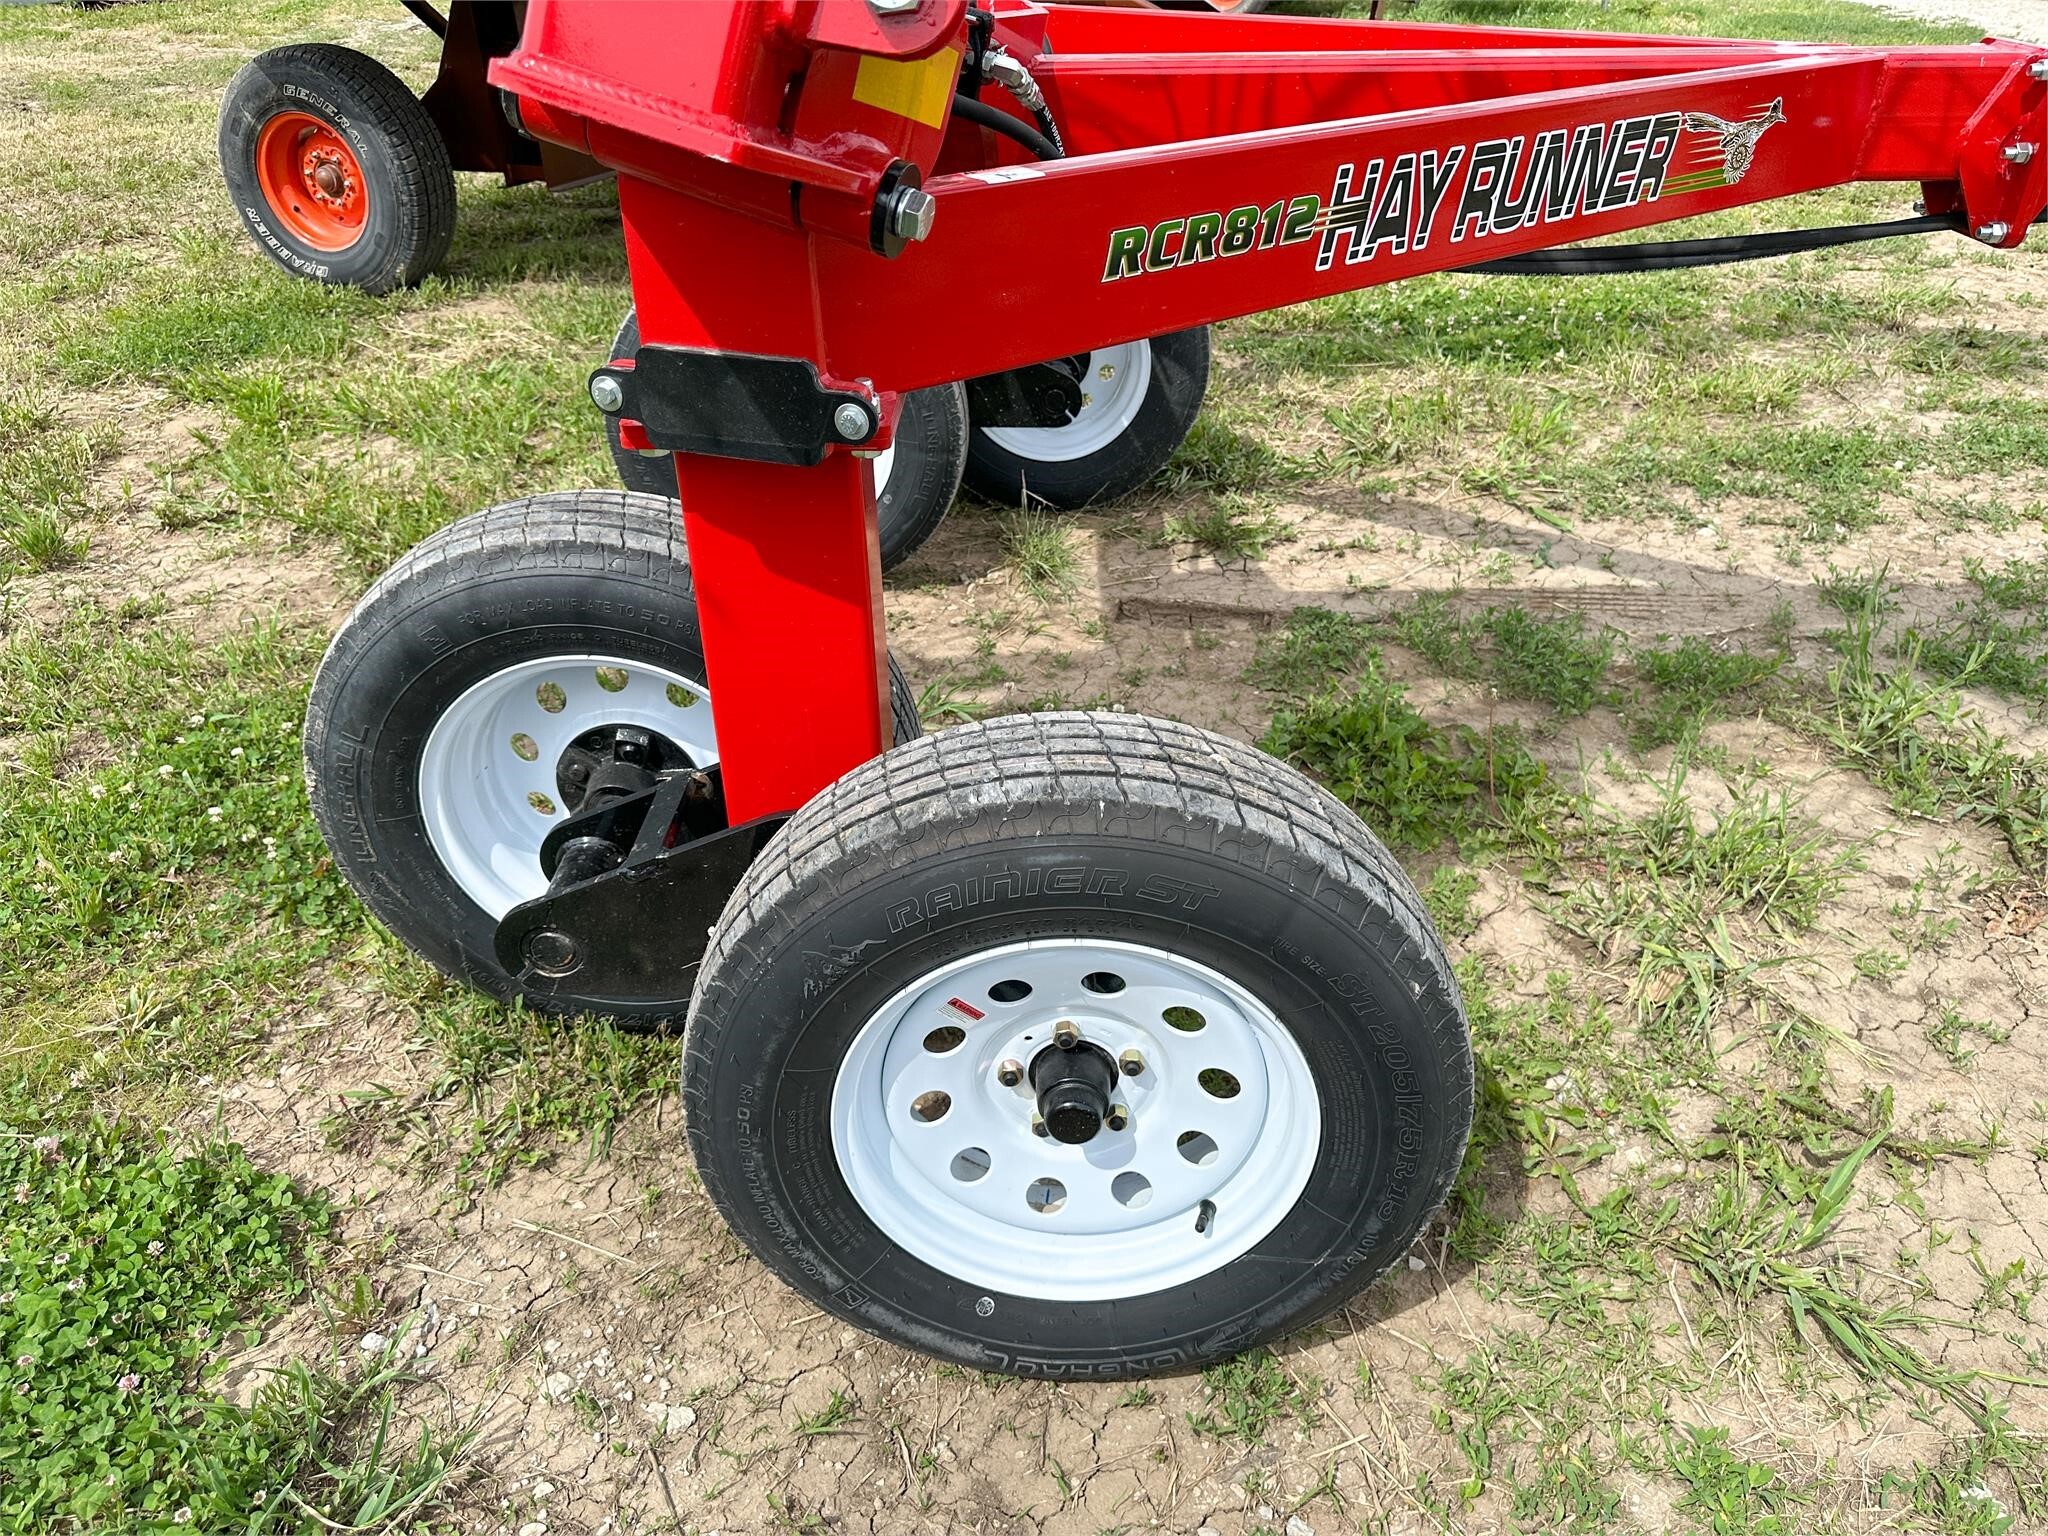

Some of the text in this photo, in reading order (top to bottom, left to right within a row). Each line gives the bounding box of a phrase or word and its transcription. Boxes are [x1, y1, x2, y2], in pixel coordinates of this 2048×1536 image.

[283, 84, 369, 160] GENERAL
[1101, 112, 1682, 282] RCR812 HAY RUNNER
[616, 604, 634, 616] TO
[640, 608, 670, 624] 50
[884, 867, 1223, 934] RAINIER ST
[1272, 934, 1299, 957] TIRE
[1326, 971, 1387, 1017] ST
[737, 1083, 822, 1280] FOR MAX LOAD INFLATE TO 50 PSI
[983, 1348, 1186, 1376] LONGHAUL
